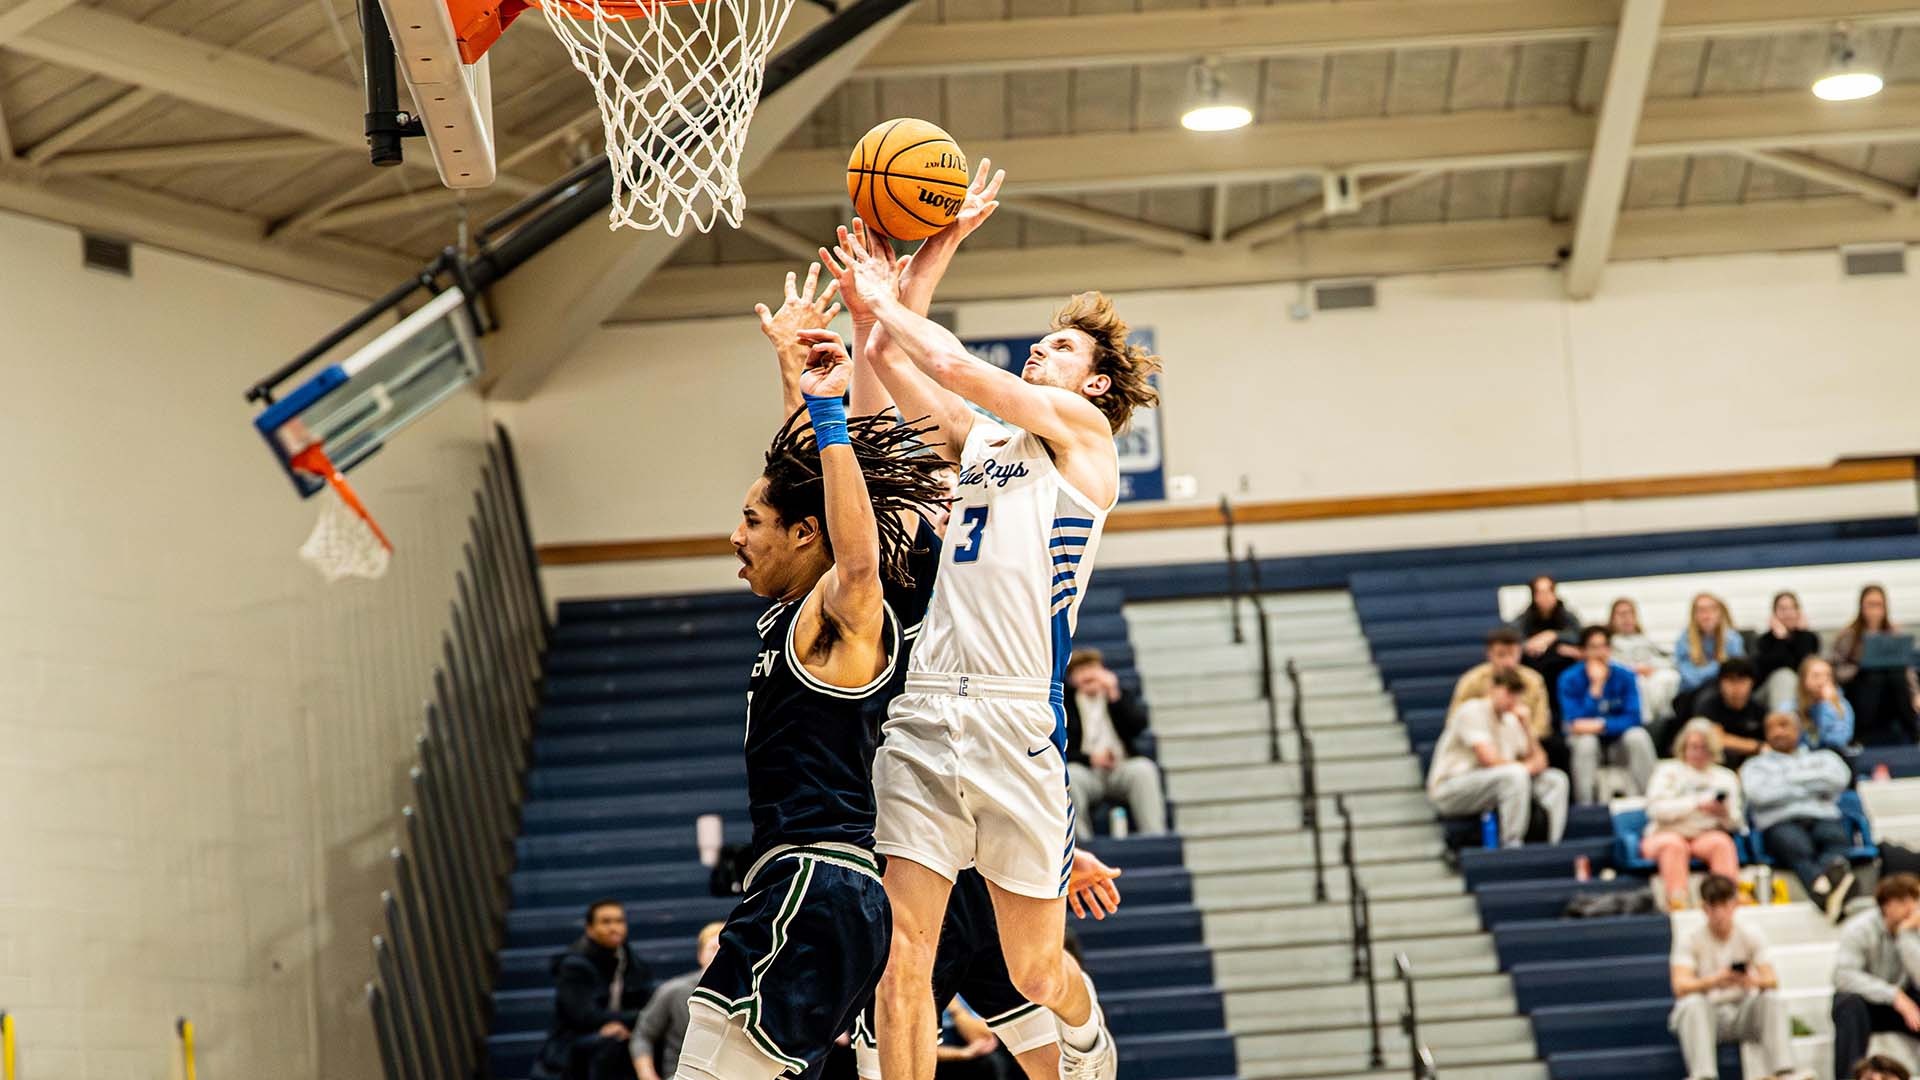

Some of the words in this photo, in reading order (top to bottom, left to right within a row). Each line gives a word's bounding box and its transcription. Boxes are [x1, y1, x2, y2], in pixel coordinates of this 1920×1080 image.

[918, 188, 965, 217] ilson
[953, 504, 989, 565] 3
[959, 677, 969, 697] E
